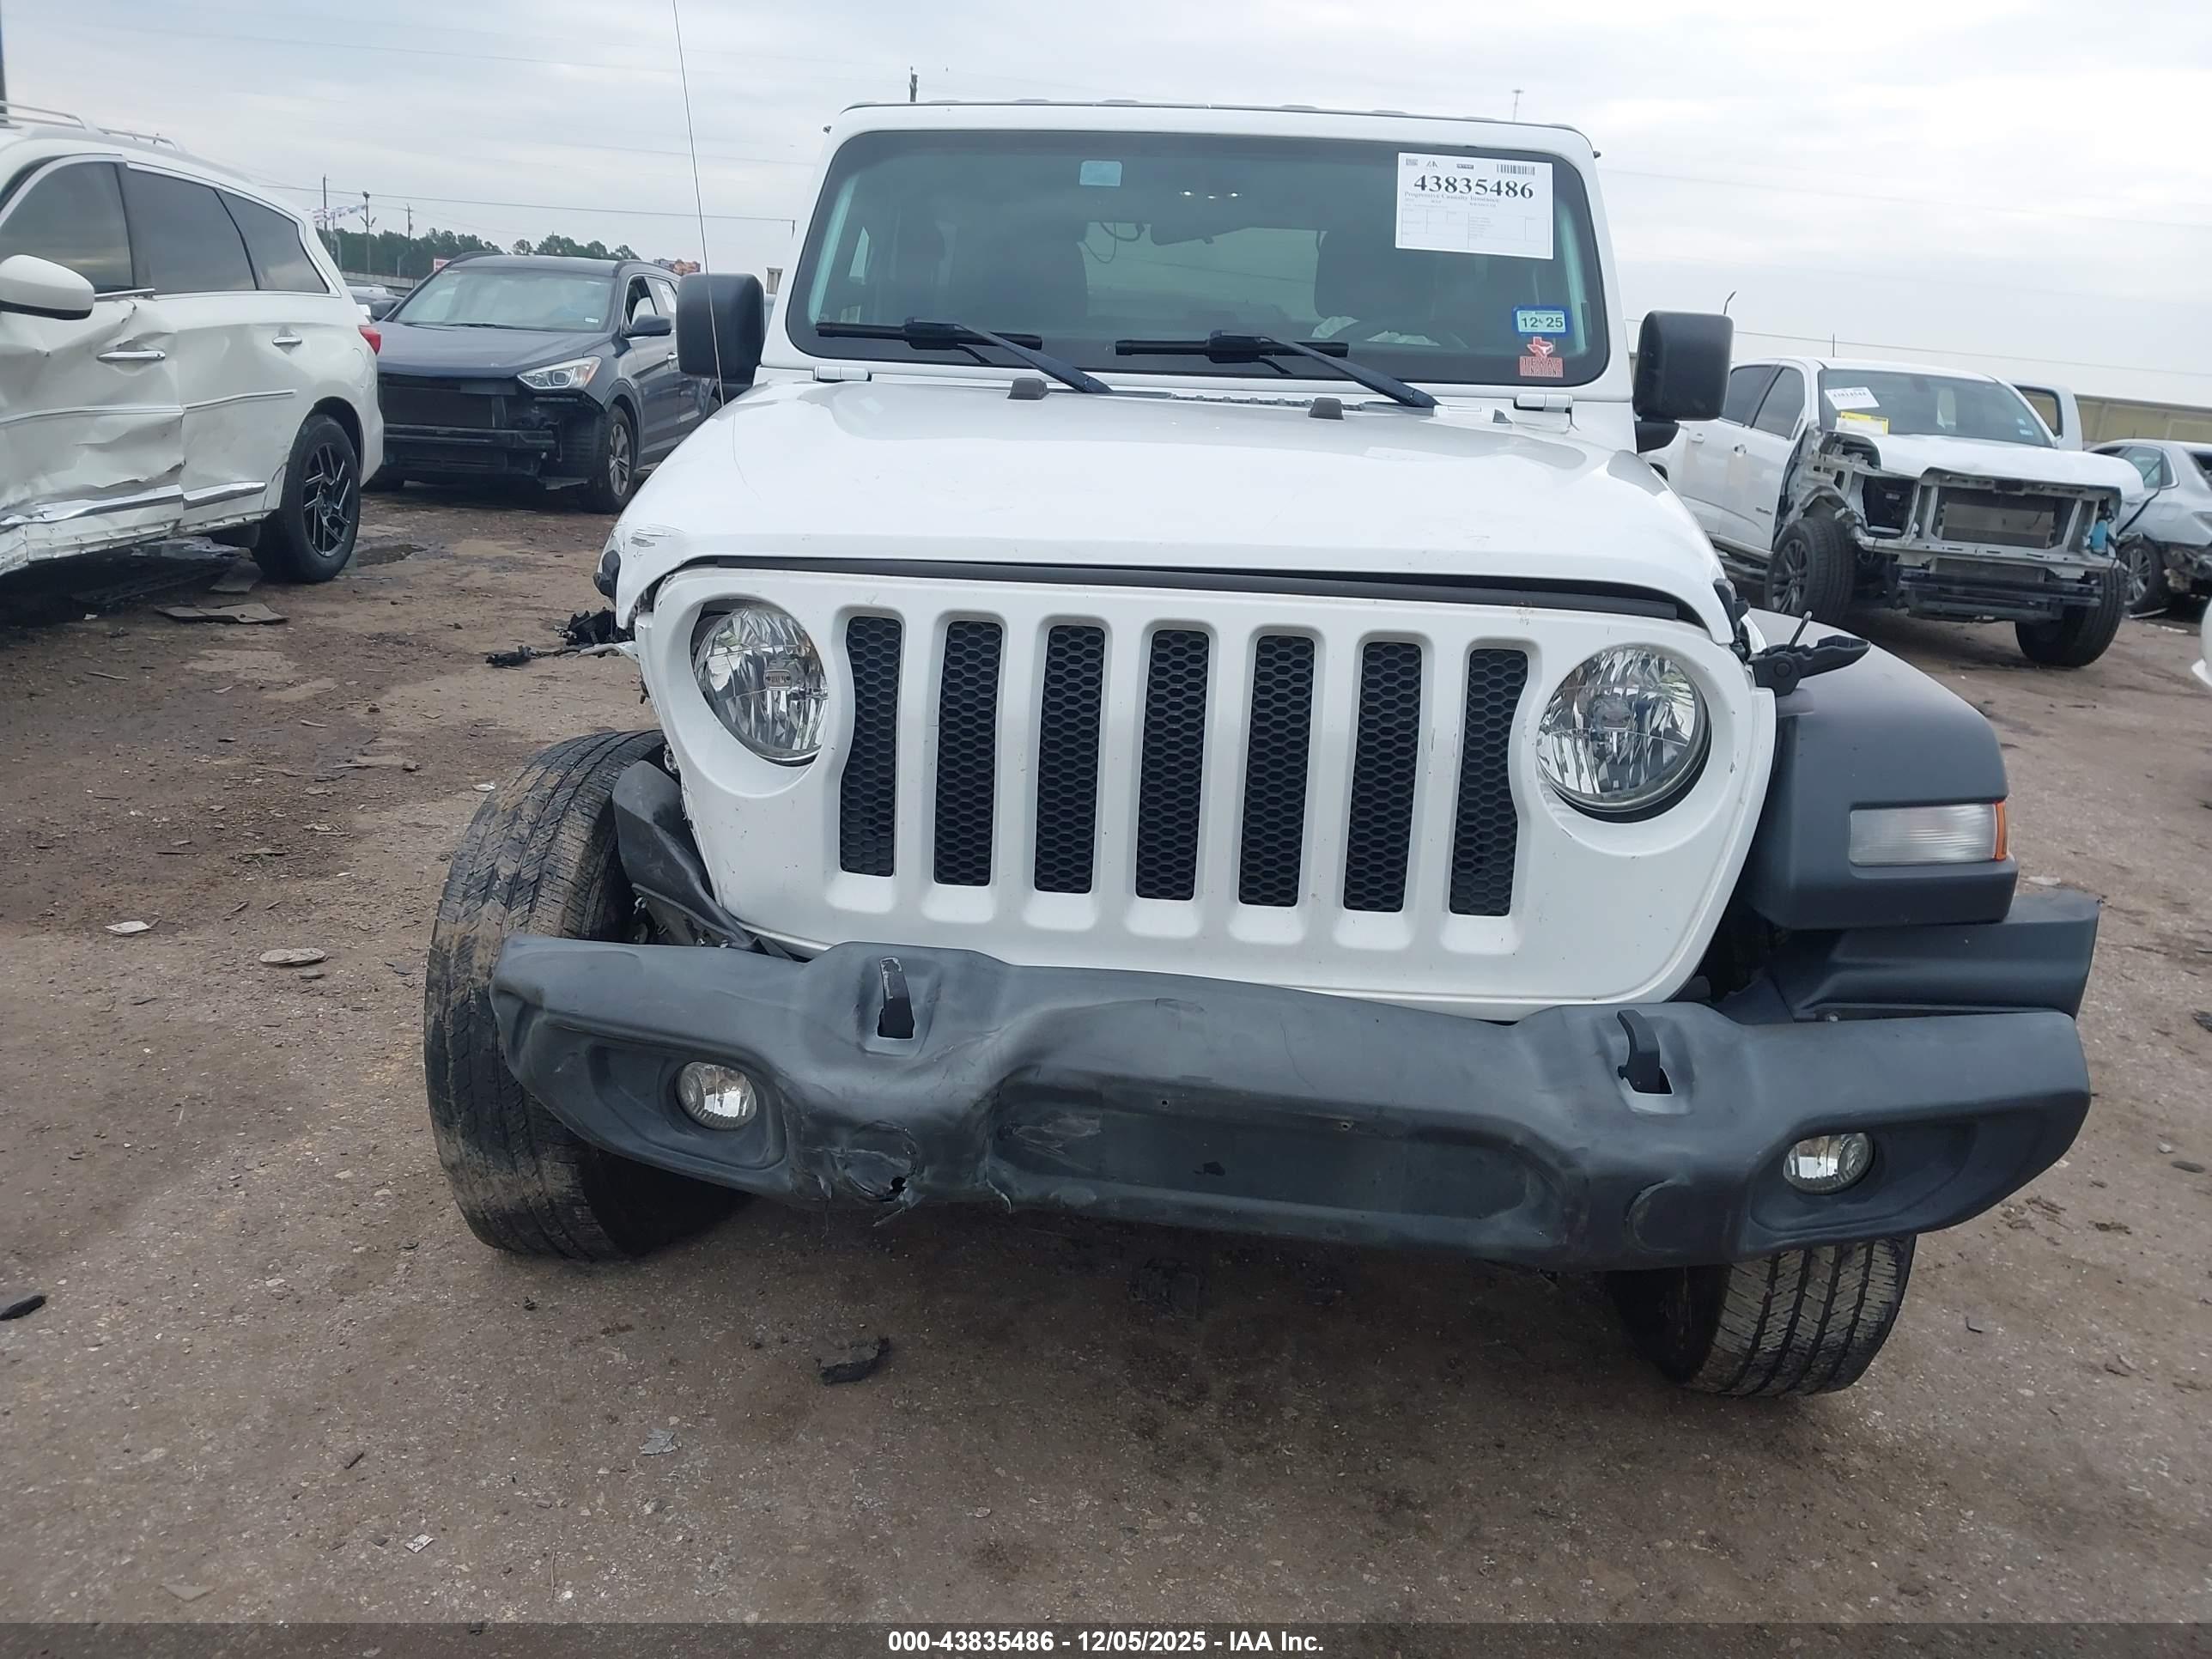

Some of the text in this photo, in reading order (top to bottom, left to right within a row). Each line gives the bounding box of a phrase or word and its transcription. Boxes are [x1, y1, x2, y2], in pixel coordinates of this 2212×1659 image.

[1413, 174, 1534, 199] 43835486
[1522, 317, 1564, 328] 12 25
